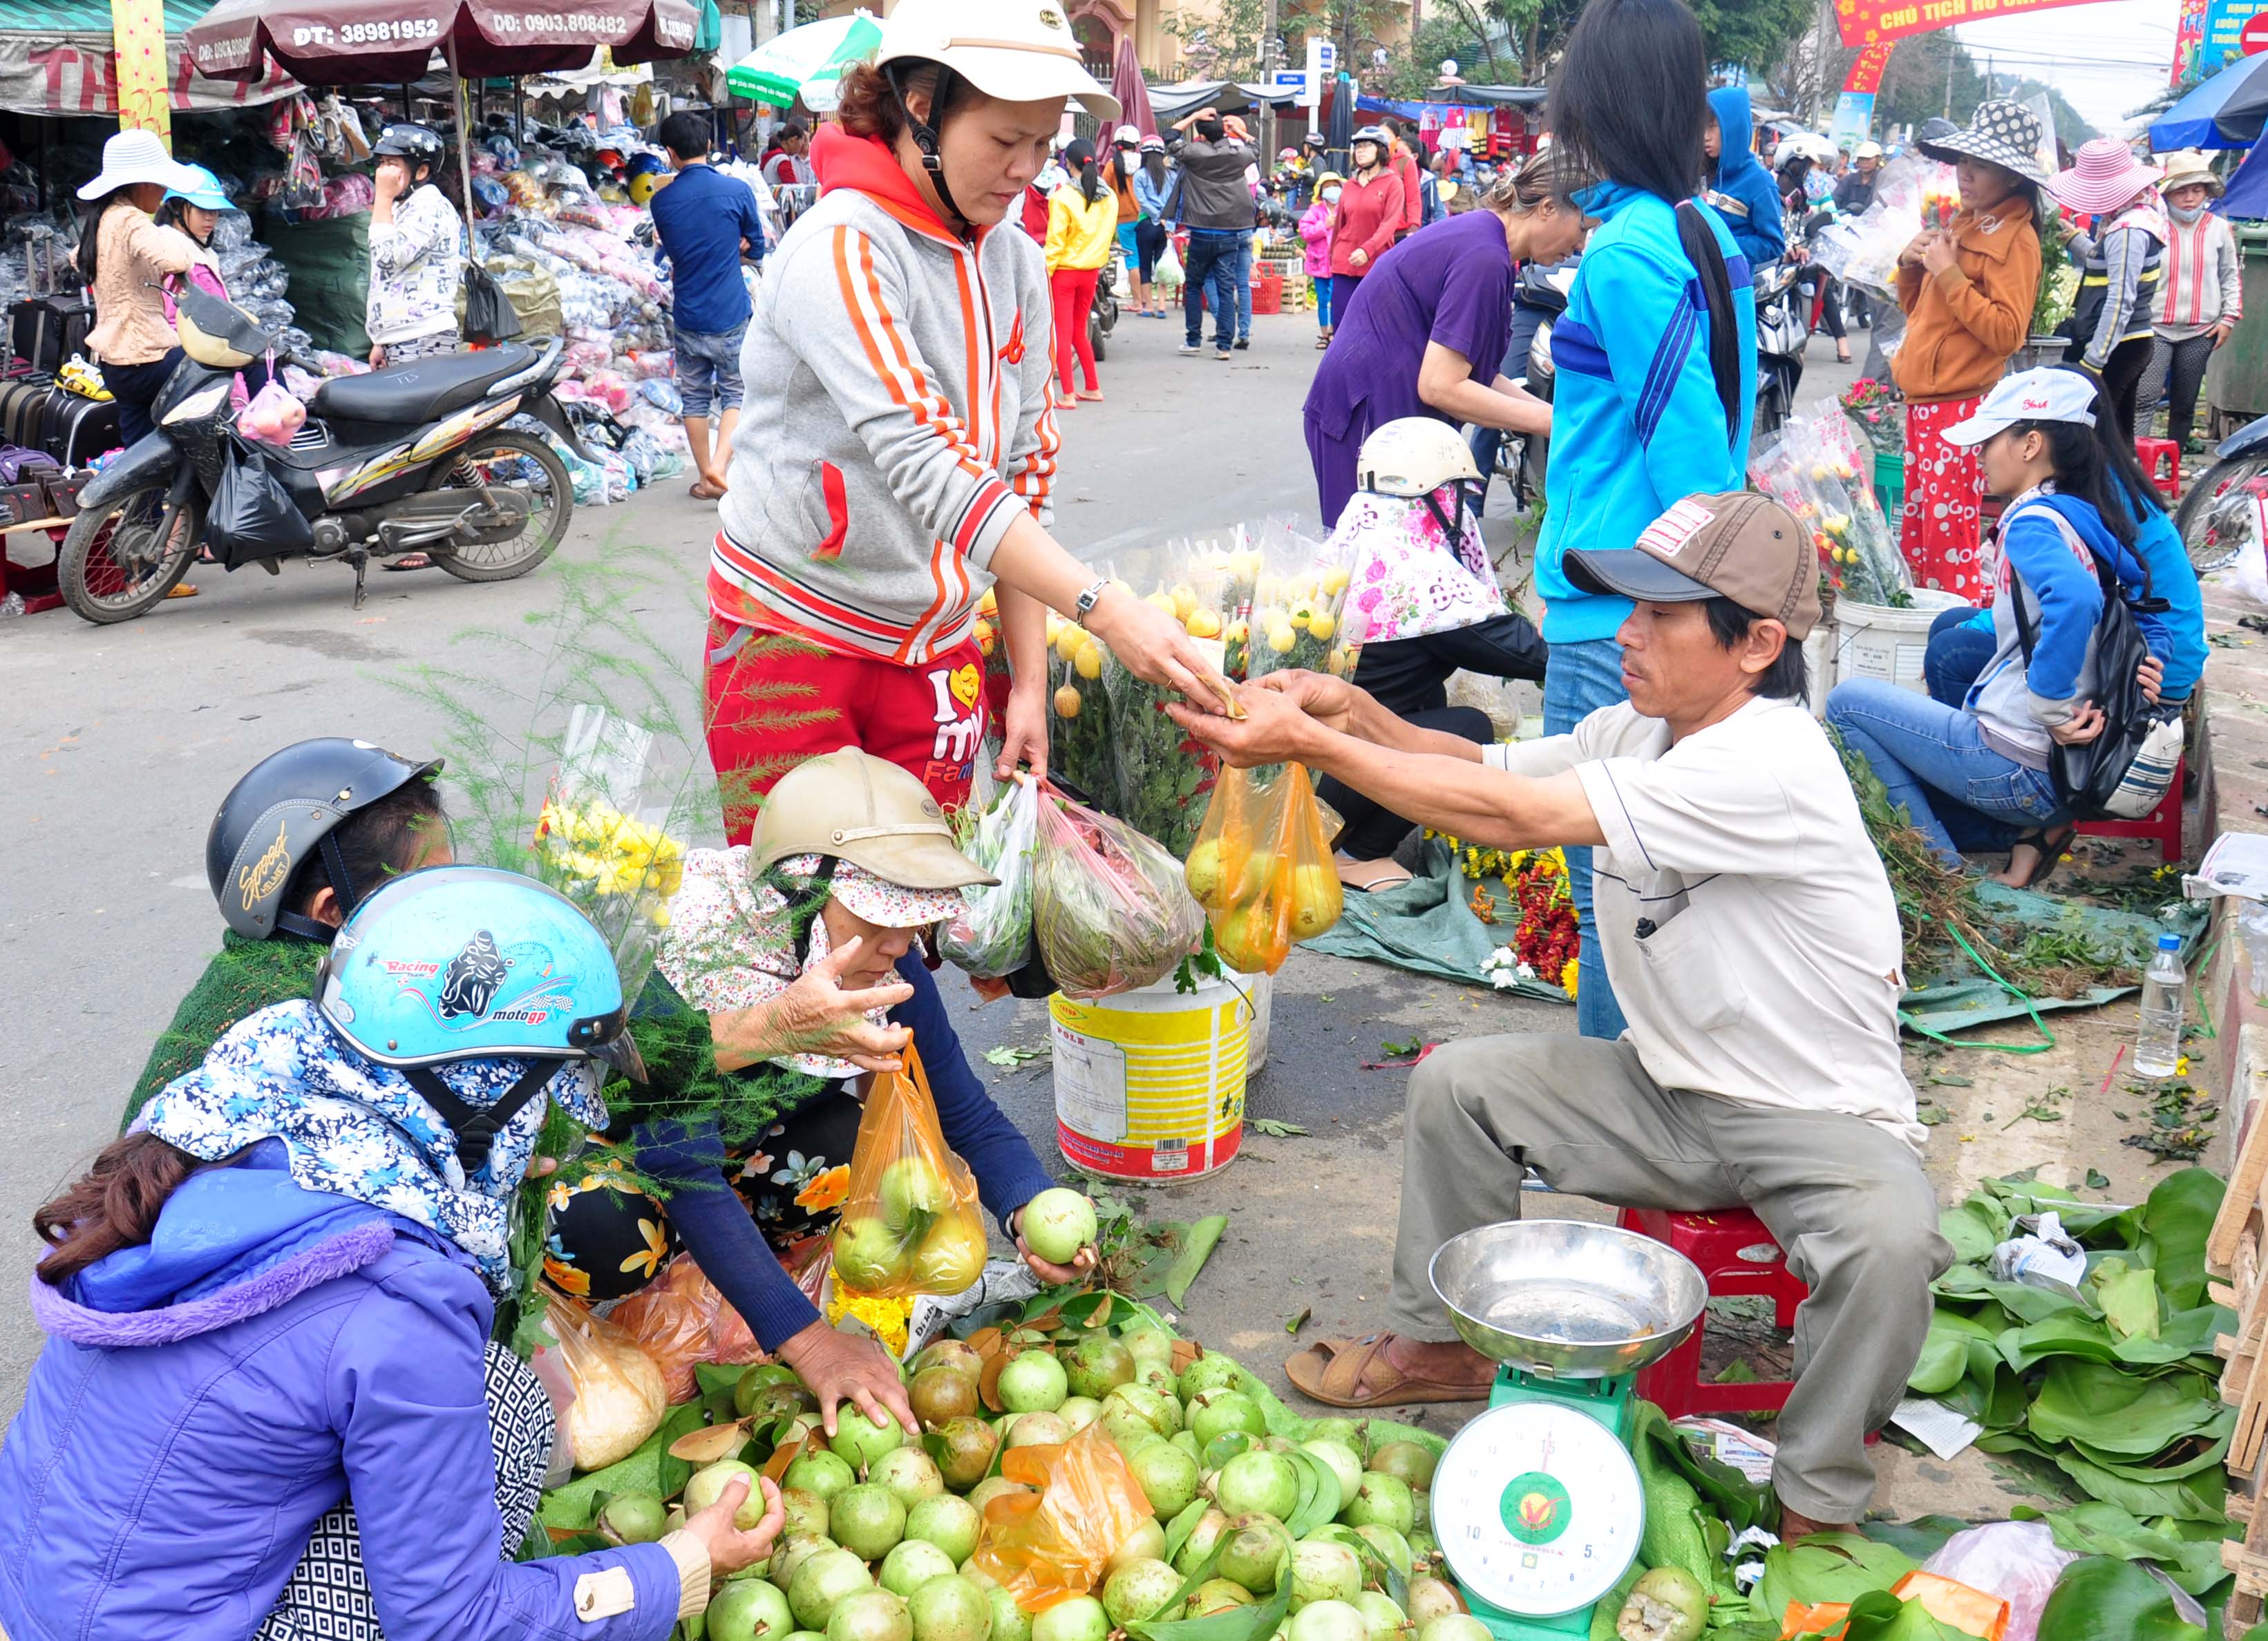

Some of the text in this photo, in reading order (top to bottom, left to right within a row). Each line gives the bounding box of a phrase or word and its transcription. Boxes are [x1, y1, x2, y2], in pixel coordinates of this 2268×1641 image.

[525, 14, 627, 34] 0903.808482
[1880, 4, 1918, 30] CHỦ
[1922, 0, 1966, 21] TỊCH
[294, 19, 438, 46] ĐT: 38981952
[927, 670, 958, 722] I
[933, 704, 983, 762] my
[239, 819, 287, 911] Speed
[260, 861, 287, 894] HELMET
[385, 960, 440, 973] Racing
[492, 1010, 547, 1024] motogp
[1465, 1525, 1481, 1540] 10
[1609, 1526, 1614, 1535] 4
[1583, 1544, 1593, 1559] 5
[1569, 1573, 1575, 1582] 6
